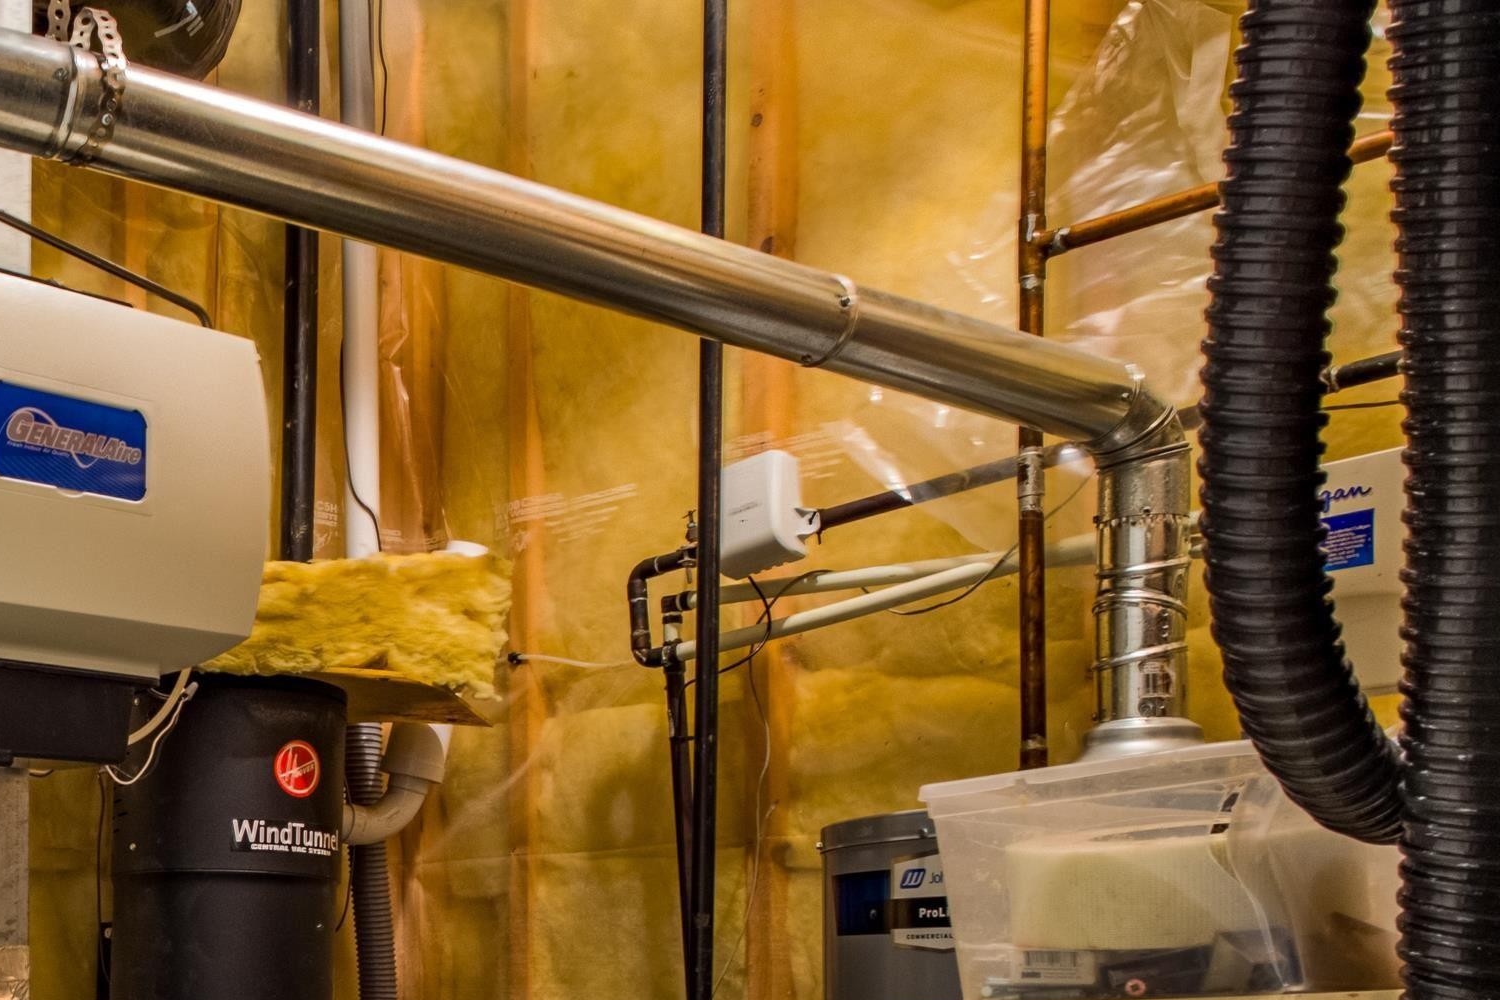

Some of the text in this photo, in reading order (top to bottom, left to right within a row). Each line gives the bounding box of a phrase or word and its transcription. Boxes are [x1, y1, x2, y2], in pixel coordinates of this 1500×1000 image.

[1319, 485, 1372, 513] gan
[232, 818, 339, 852] WindTunnel
[250, 843, 290, 852] CENTRAL
[308, 848, 332, 857] SYSTEM
